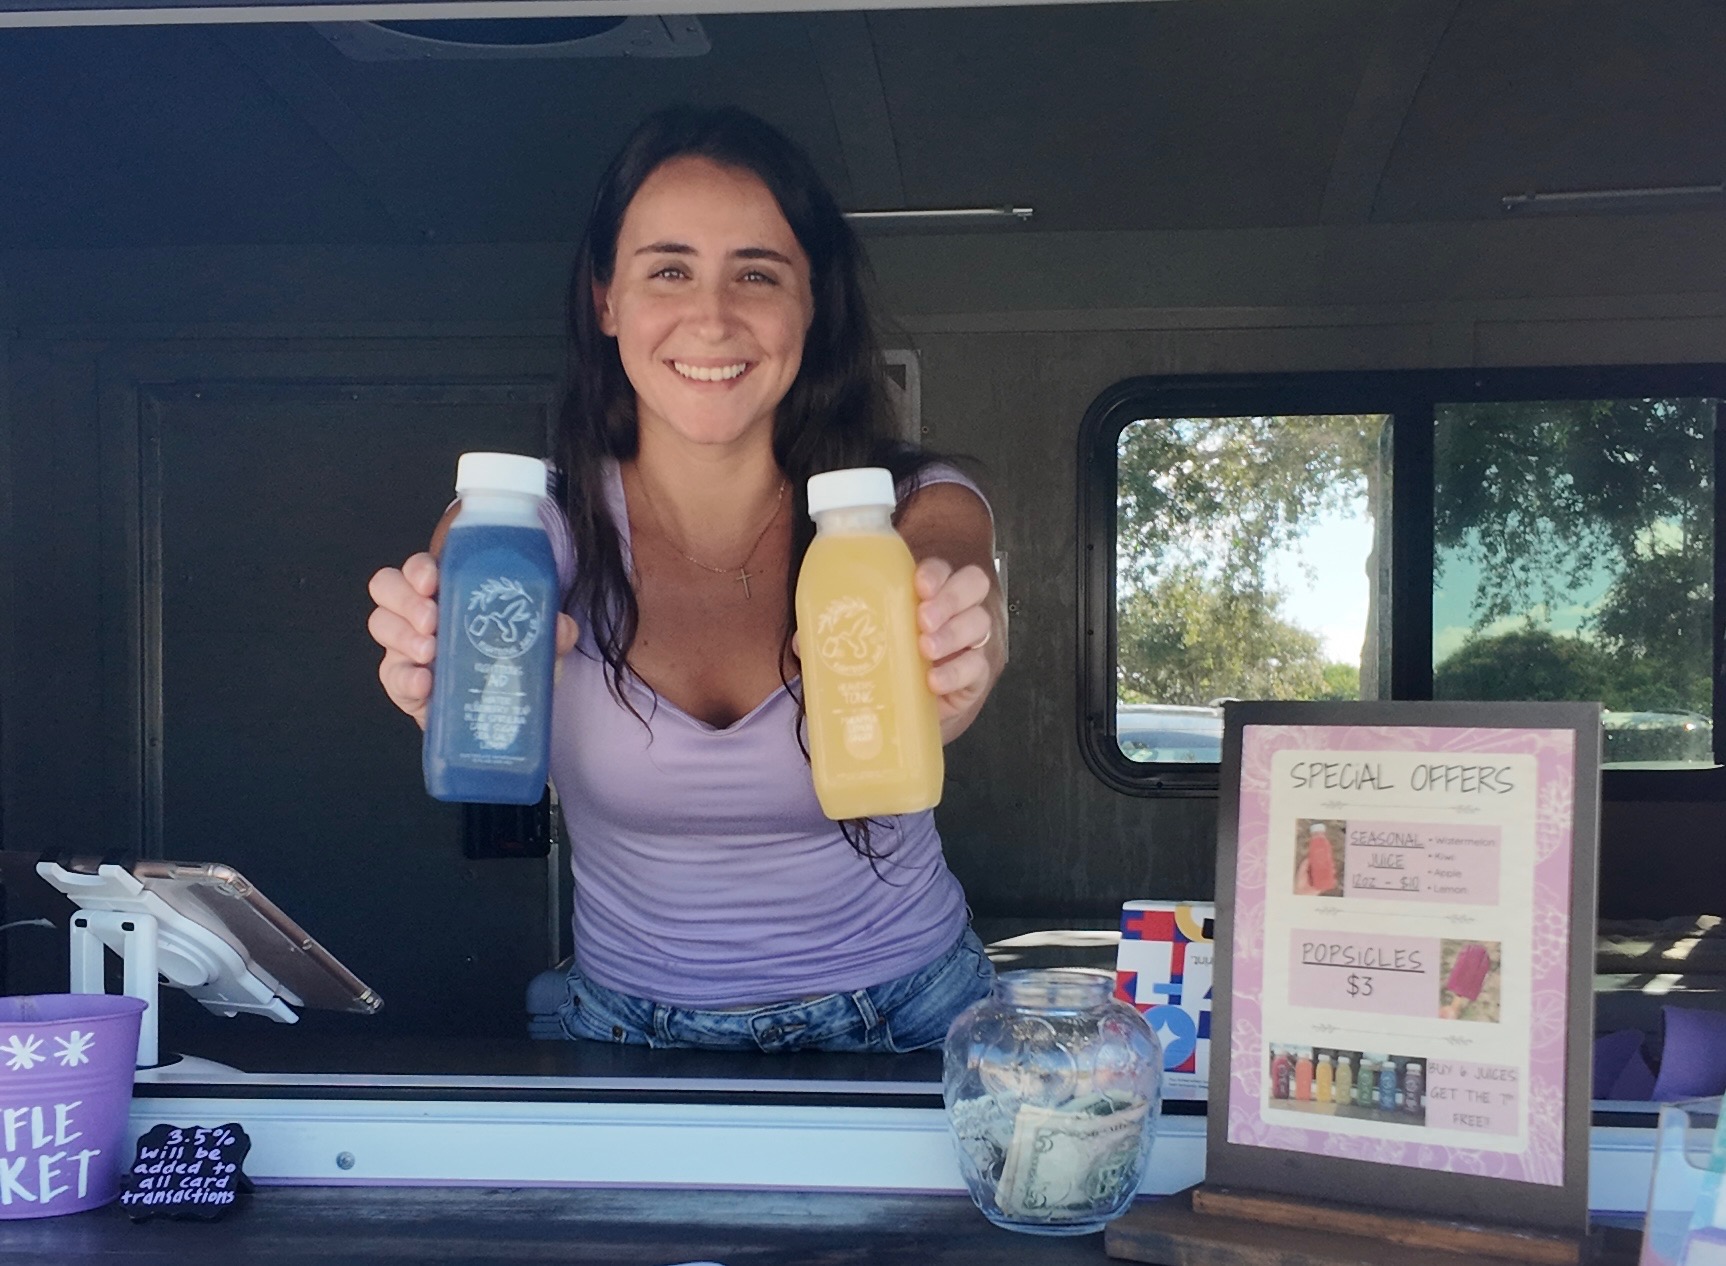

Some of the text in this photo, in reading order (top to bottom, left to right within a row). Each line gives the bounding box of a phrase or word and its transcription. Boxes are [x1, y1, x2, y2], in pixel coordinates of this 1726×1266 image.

[1290, 761, 1515, 794] SPECIAL OFFERS
[1350, 830, 1424, 848] SEASONAL
[1435, 837, 1496, 847] Watermelon
[1367, 852, 1405, 869] JUICE
[1434, 869, 1463, 879] Apple
[1399, 876, 1420, 891] $10
[1434, 885, 1468, 894] Lemon
[1302, 941, 1425, 970] POPSICLES
[1346, 974, 1374, 998] $3
[1428, 1062, 1518, 1082] BUY 6 JUICES
[1430, 1086, 1459, 1100] GET
[1465, 1089, 1492, 1105] THE
[0, 1100, 83, 1152] FLE
[166, 1128, 236, 1146] 3.5%
[140, 1146, 222, 1161] will be
[133, 1160, 237, 1175] added to
[138, 1175, 231, 1189] all card
[120, 1188, 236, 1205] transactions
